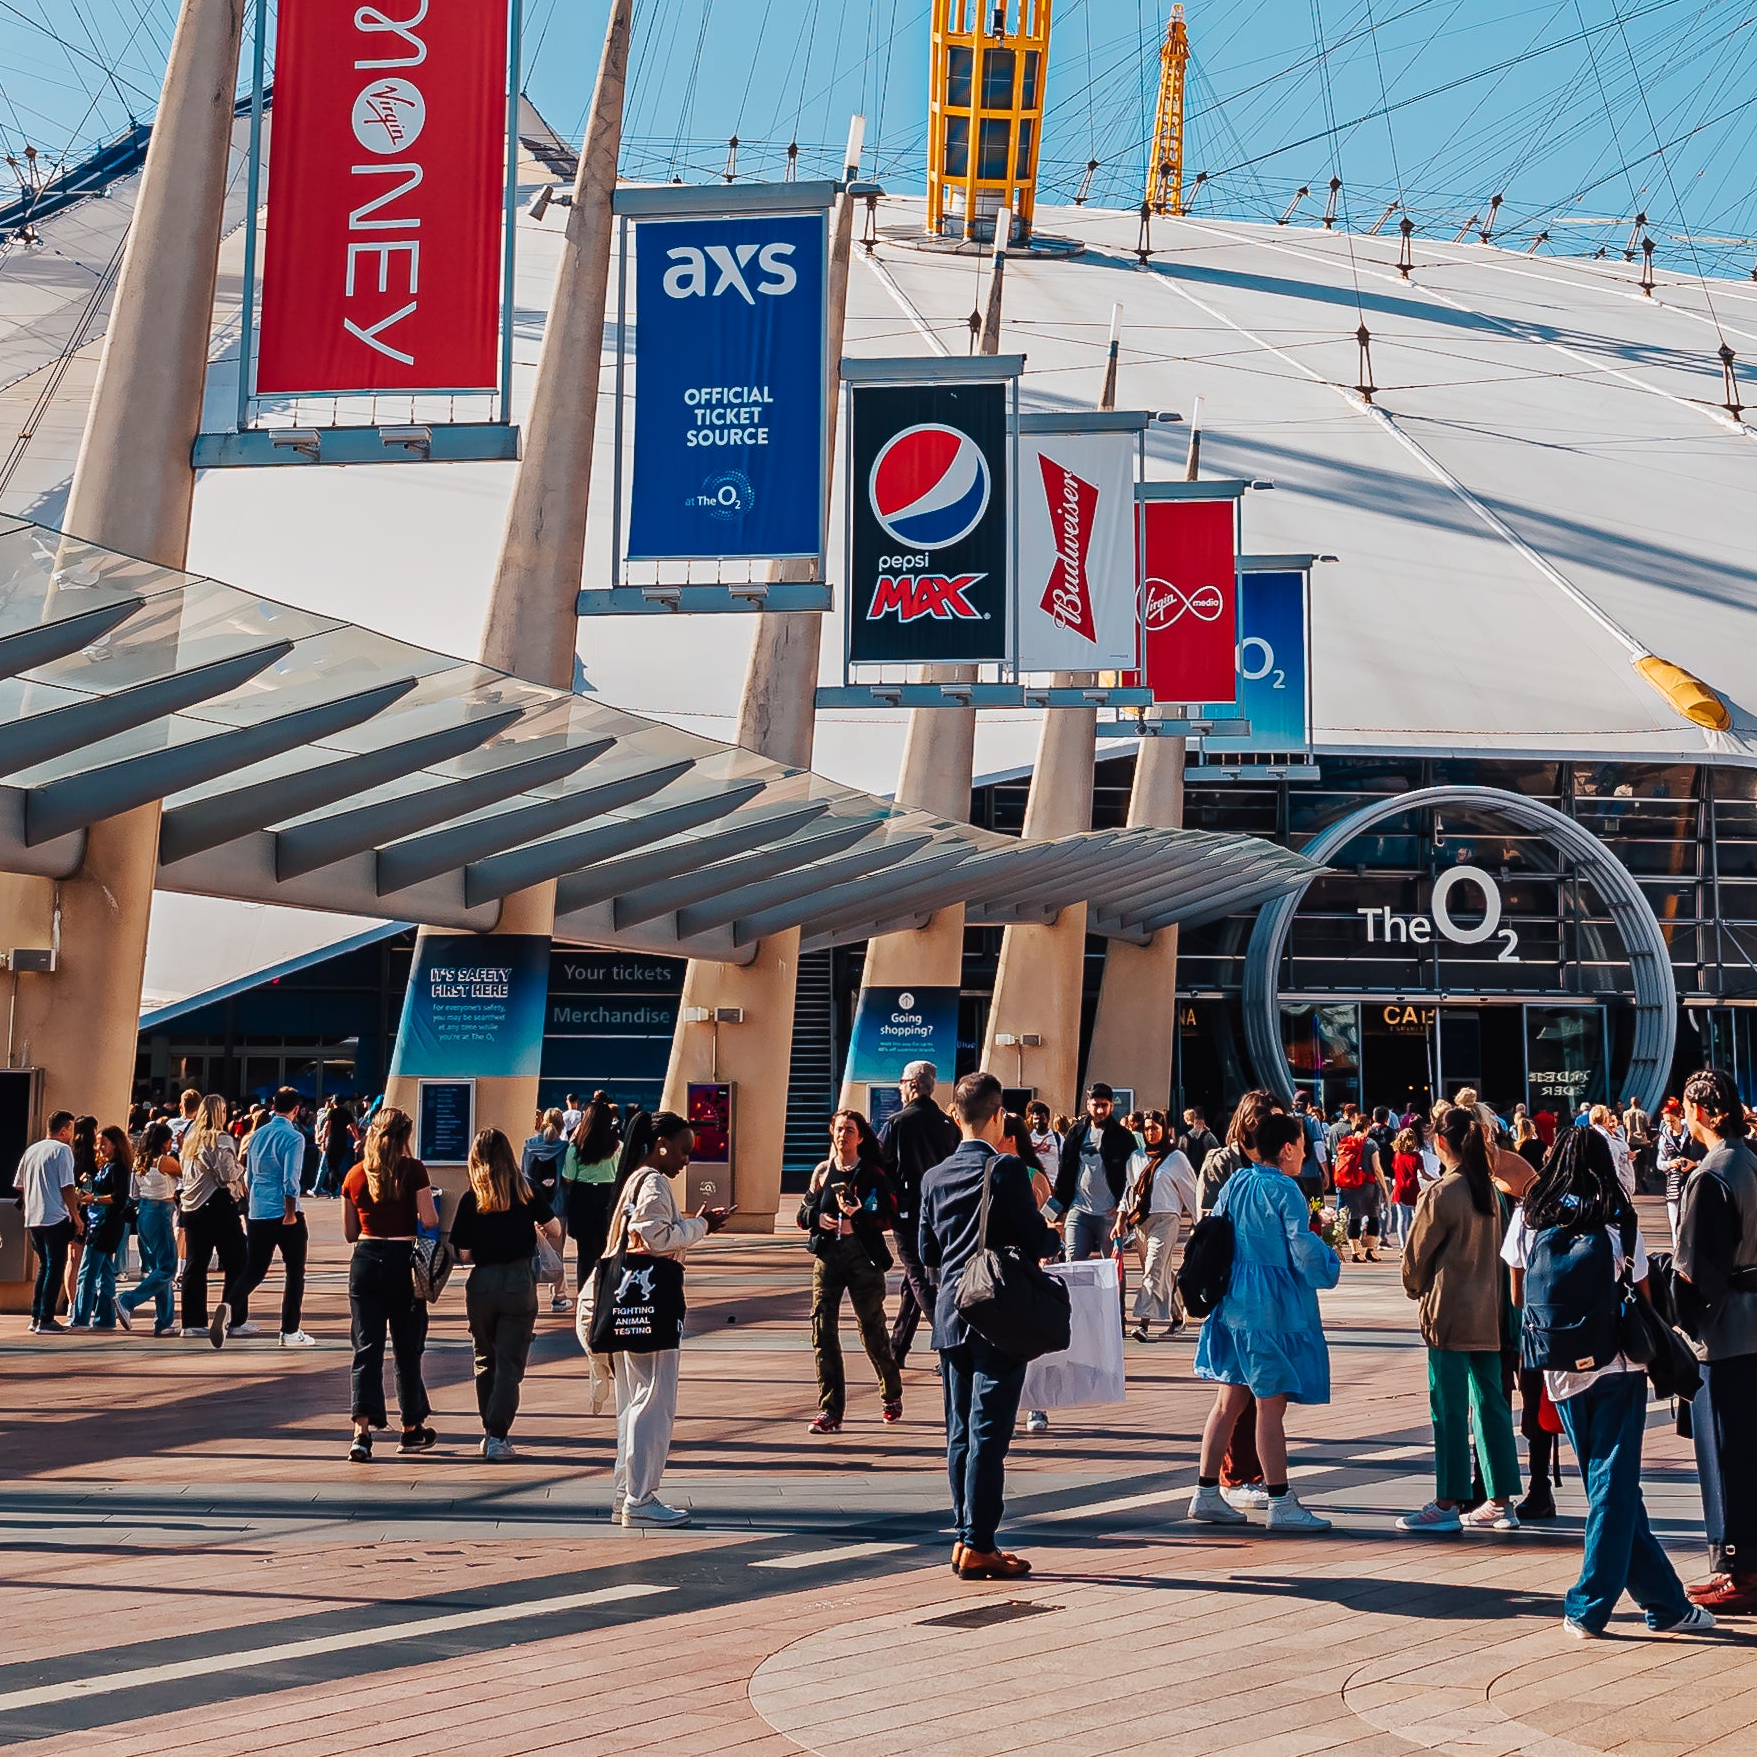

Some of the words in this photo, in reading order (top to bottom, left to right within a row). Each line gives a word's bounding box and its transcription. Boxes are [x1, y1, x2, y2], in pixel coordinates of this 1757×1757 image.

[364, 84, 417, 147] Virgin
[662, 242, 797, 305] axs
[683, 385, 774, 406] OFFICIAL
[694, 407, 762, 426] TICKET
[686, 427, 769, 447] SOURCE
[685, 497, 695, 506] at
[696, 495, 717, 506] The
[1052, 469, 1082, 630] Budweiser
[878, 552, 929, 572] pepsi
[866, 572, 989, 623] MAX
[1235, 637, 1286, 689] O2
[1357, 906, 1431, 944] The
[1431, 865, 1520, 962] O2
[430, 968, 455, 982] IT'S
[457, 968, 512, 982] SAFETY
[563, 964, 607, 980] Your
[611, 963, 672, 980] tickets
[431, 984, 469, 998] FIRST
[471, 984, 509, 998] HERE
[553, 1006, 671, 1024] Merchandise
[890, 1013, 923, 1025] Going
[879, 1024, 934, 1038] shopping?
[612, 1306, 655, 1316] FIGHTING
[615, 1316, 651, 1326] ANIMAL
[613, 1326, 652, 1336] TESTING
